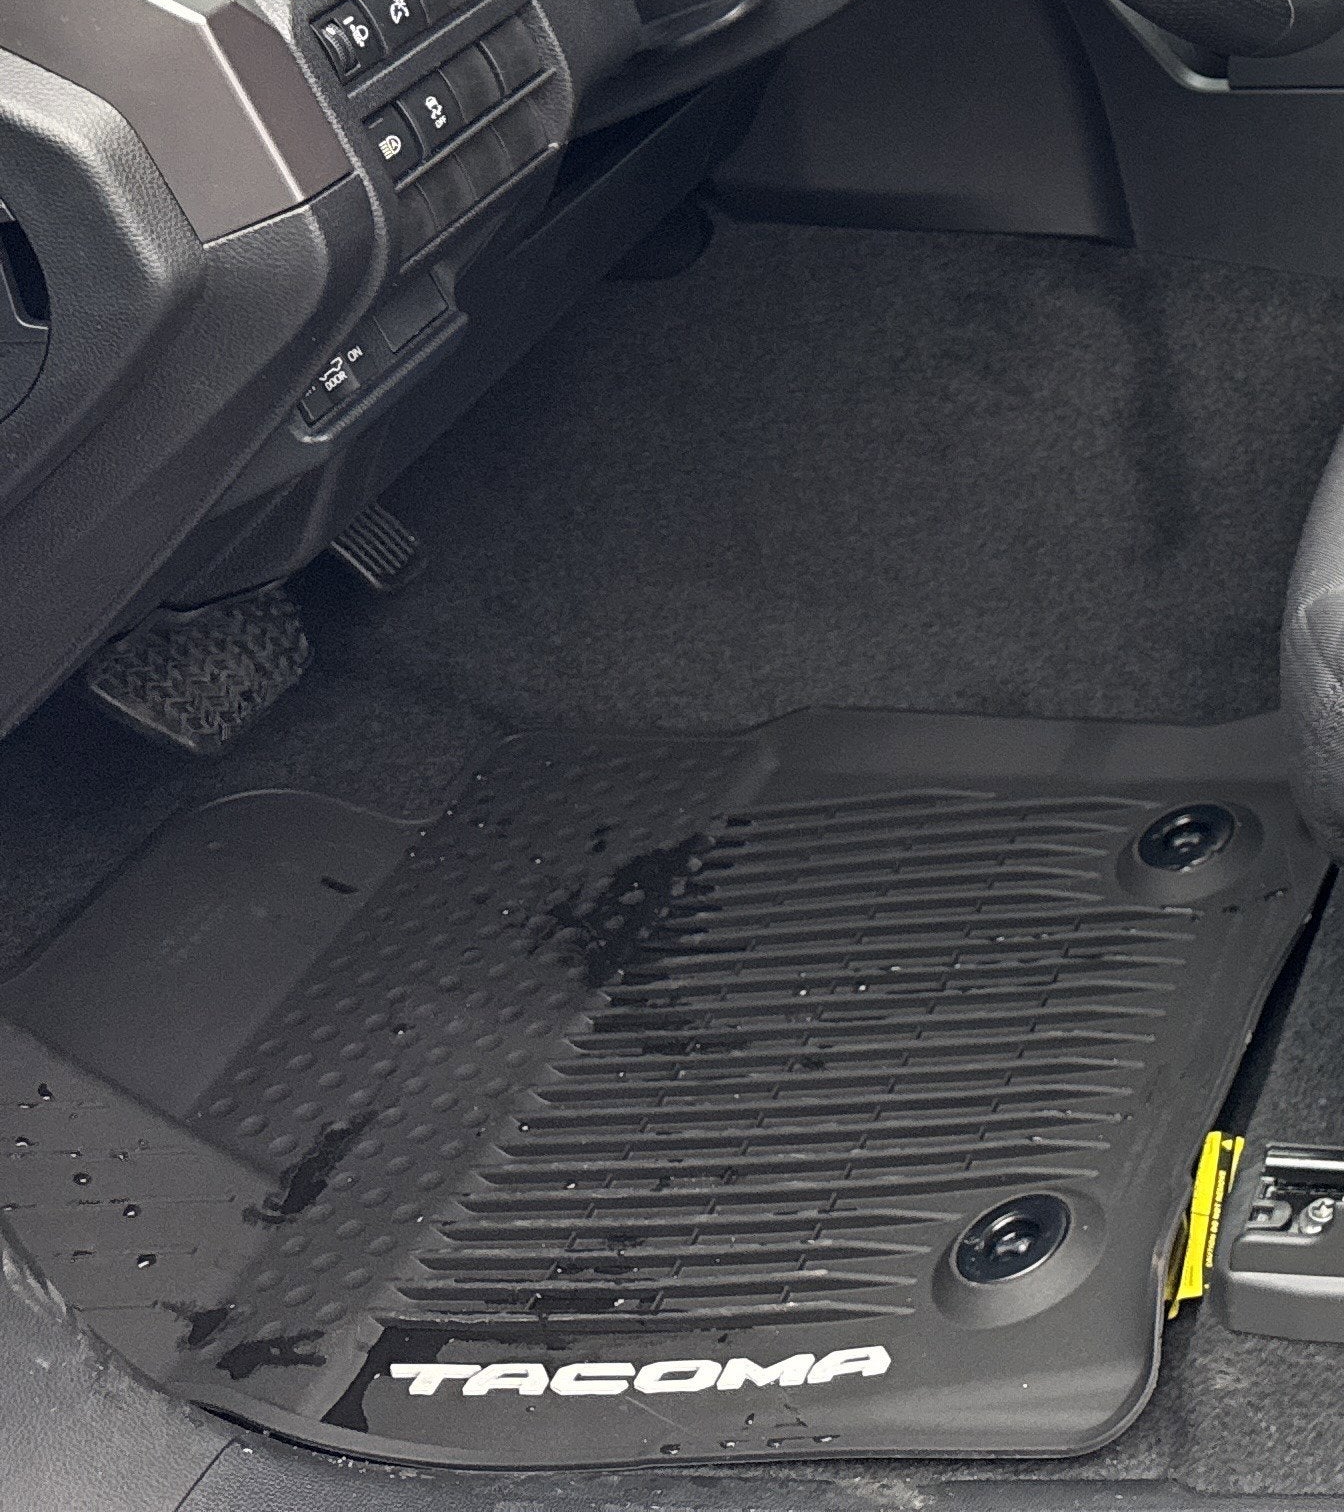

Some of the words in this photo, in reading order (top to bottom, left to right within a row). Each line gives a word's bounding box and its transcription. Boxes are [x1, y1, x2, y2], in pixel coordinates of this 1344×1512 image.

[347, 345, 364, 363] ON
[324, 370, 349, 392] DOOR
[389, 1345, 892, 1396] TACOMA
